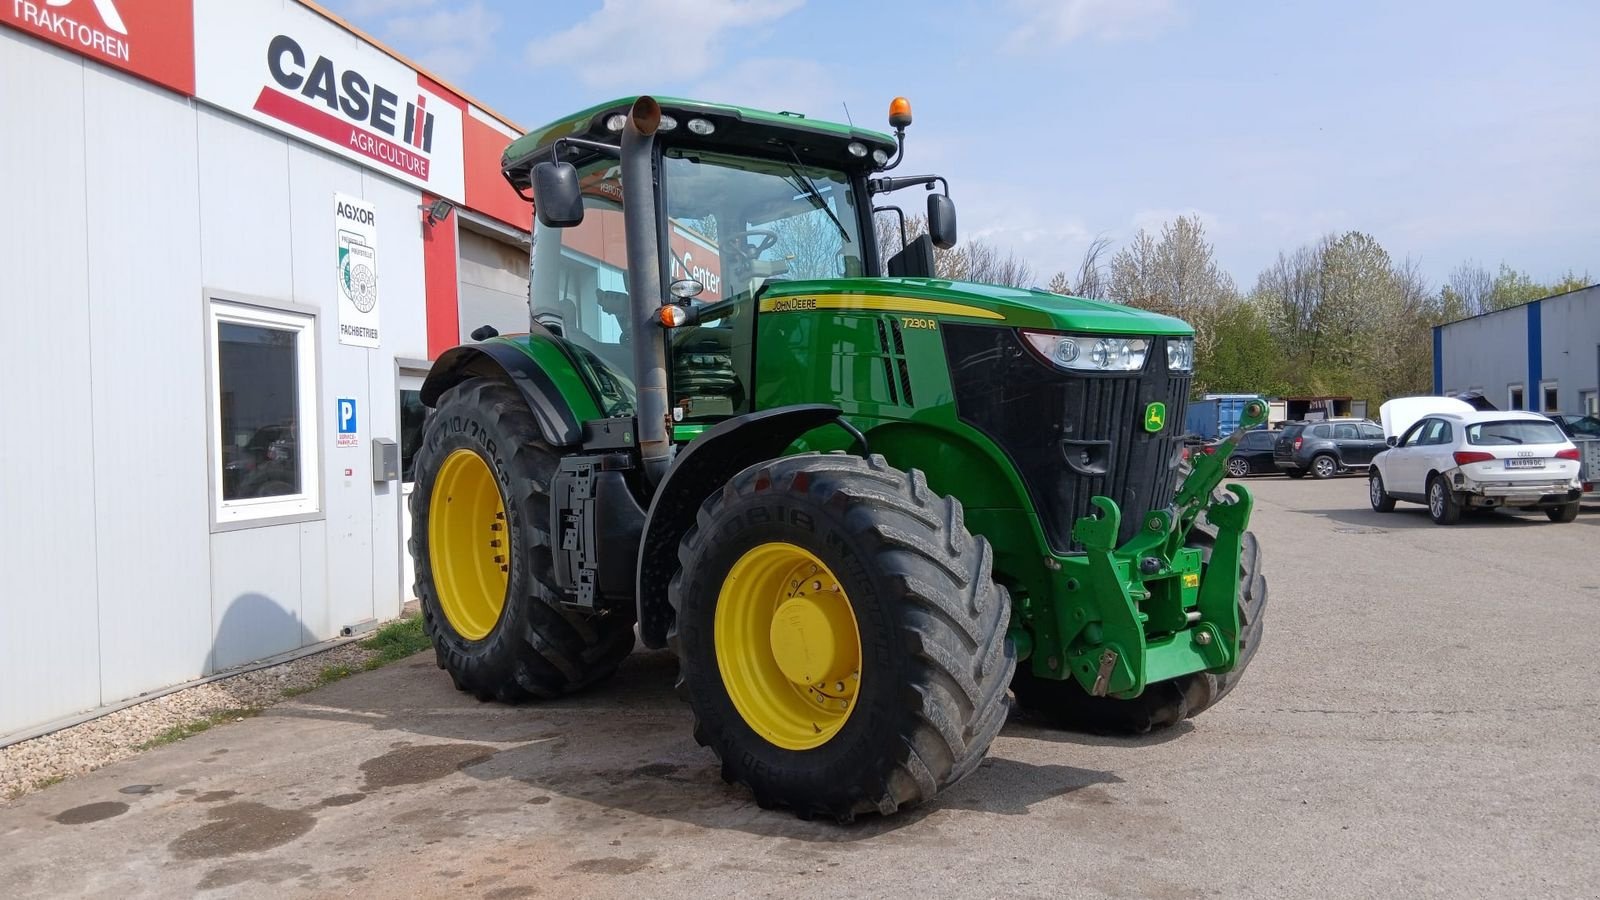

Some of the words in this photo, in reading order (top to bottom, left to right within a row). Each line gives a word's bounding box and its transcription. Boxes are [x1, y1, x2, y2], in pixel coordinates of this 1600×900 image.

[12, 0, 130, 62] TRAKTOREN
[267, 34, 399, 137] CASE
[350, 130, 426, 177] AGRICULTURE
[336, 201, 375, 227] AGXOR
[683, 251, 720, 294] Center
[773, 300, 792, 311] JOHN
[792, 298, 817, 309] DEERE
[340, 323, 379, 340] FACHBETRIEB
[902, 317, 927, 329] 7230
[928, 318, 937, 330] R
[341, 401, 353, 431] P
